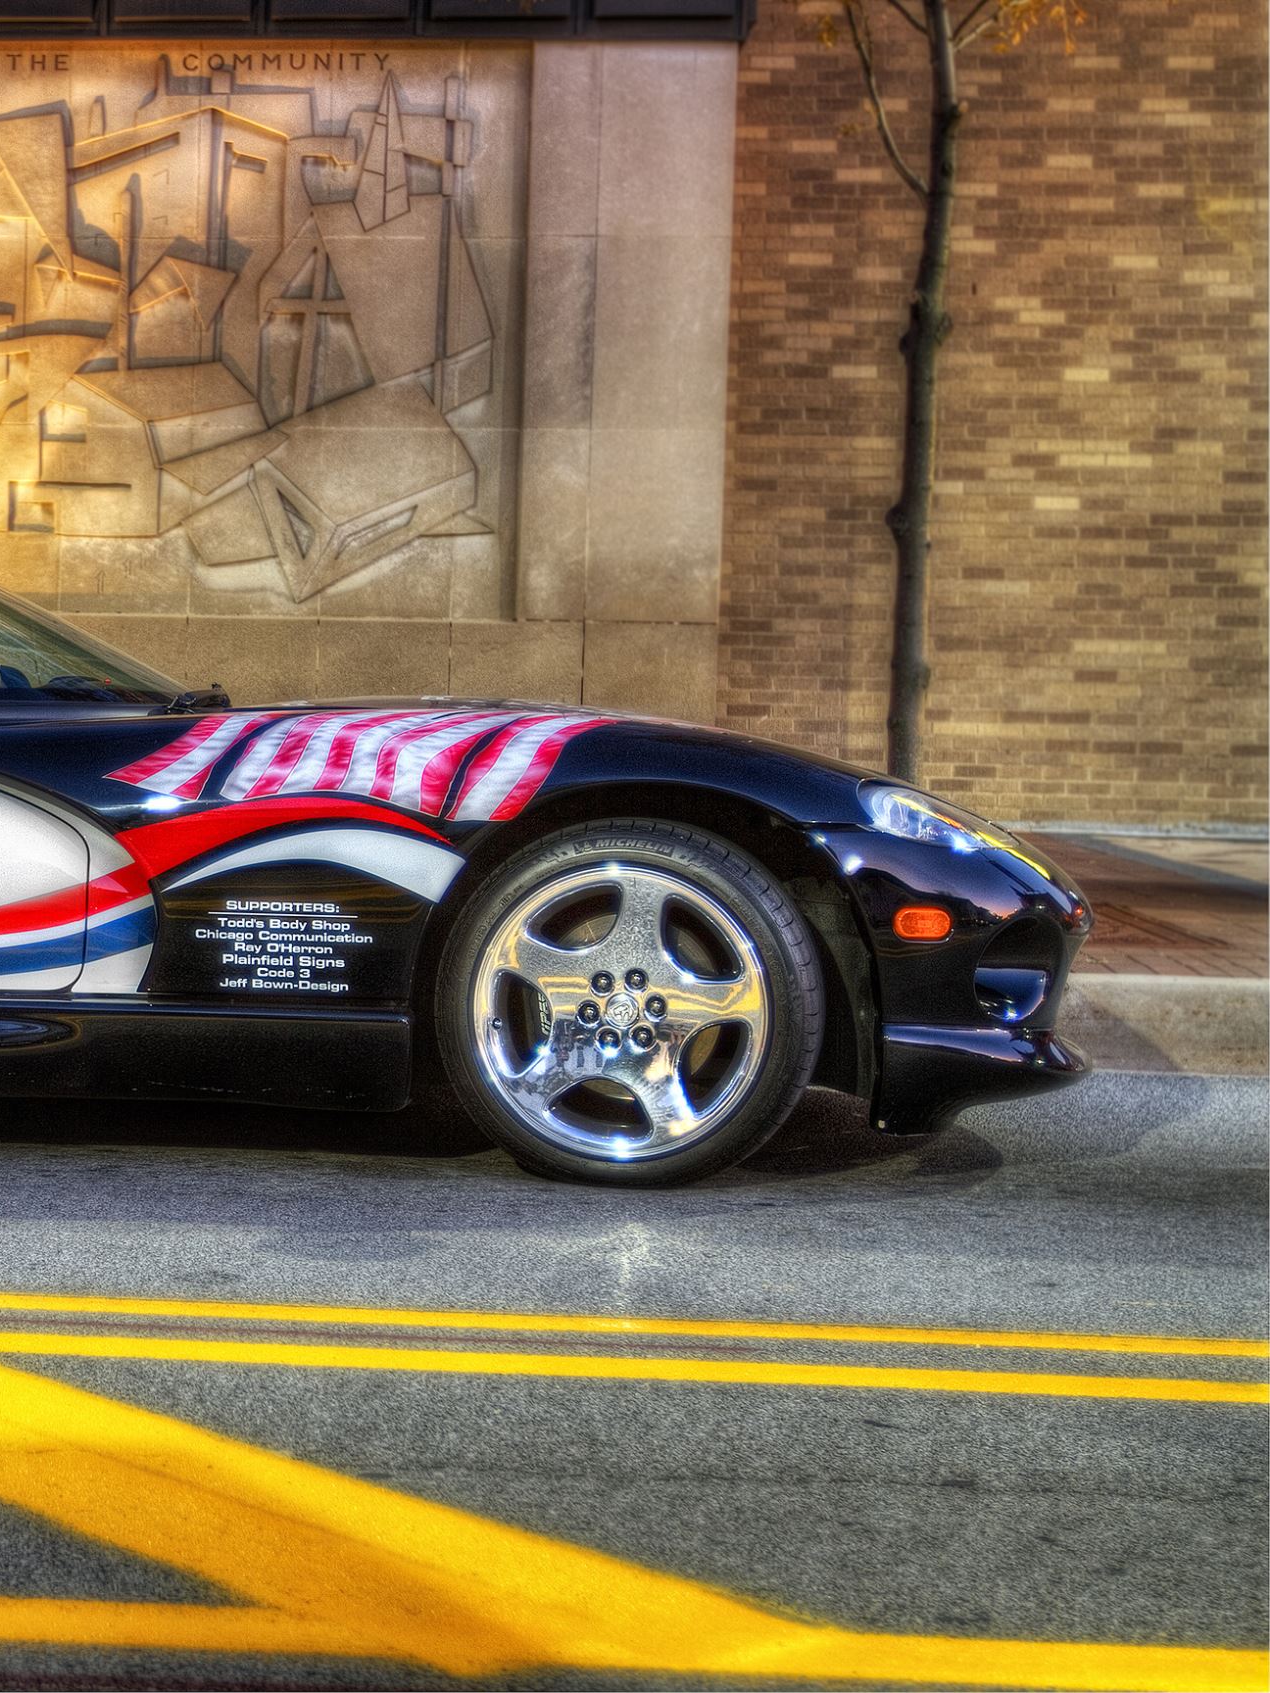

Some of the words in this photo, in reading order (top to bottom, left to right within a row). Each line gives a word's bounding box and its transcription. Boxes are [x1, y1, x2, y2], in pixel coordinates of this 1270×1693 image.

[6, 54, 70, 71] THE
[183, 53, 390, 71] COMMUNITY
[595, 838, 673, 854] MICHELIN
[226, 900, 340, 913] SUPPORTERS:
[218, 917, 265, 929] Todd's
[269, 919, 308, 931] Body
[311, 920, 351, 932] Shop
[195, 929, 254, 941] Chicago
[258, 931, 373, 944] Communication
[234, 942, 262, 954] Ray
[266, 942, 333, 954] O'Herron
[222, 954, 294, 967] Plainfield
[299, 956, 345, 969] Signs
[256, 967, 295, 978] Code
[299, 968, 311, 978] 3
[219, 978, 248, 989] Jeff
[252, 979, 349, 992] Bown-Design
